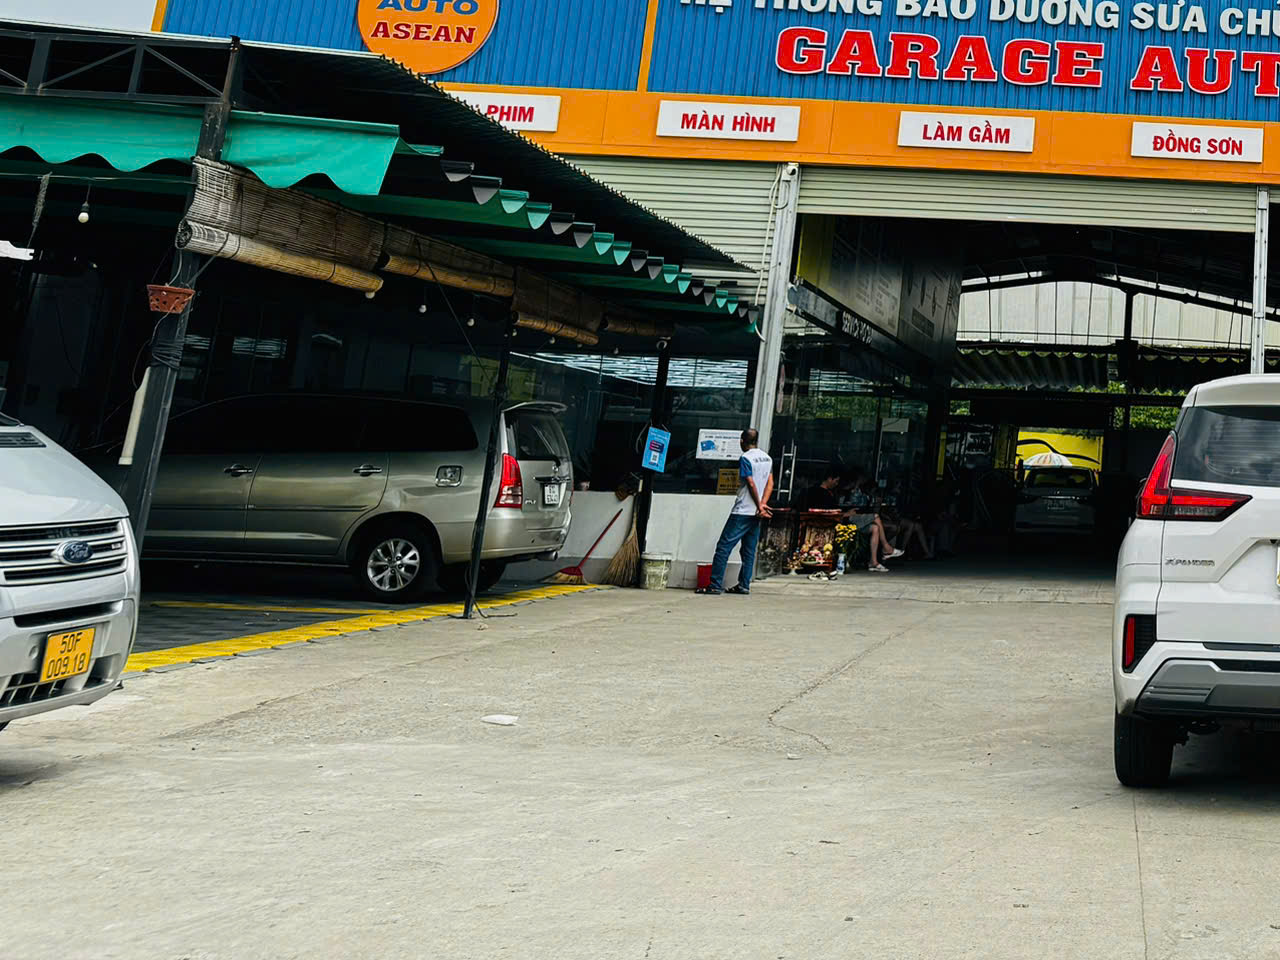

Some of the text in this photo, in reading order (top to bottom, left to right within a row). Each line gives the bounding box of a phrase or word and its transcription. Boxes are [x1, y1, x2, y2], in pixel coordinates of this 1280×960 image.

[371, 21, 477, 44] ASEAN
[775, 26, 1105, 89] GARAGE
[487, 104, 535, 123] PHIM
[681, 108, 777, 134] MÀN HÌNH
[922, 116, 1011, 145] LÀM GẦM
[1153, 129, 1243, 156] ĐỒNG SƠN
[70, 543, 91, 560] Ford
[59, 632, 84, 655] 50F
[46, 652, 87, 679] 009.18
